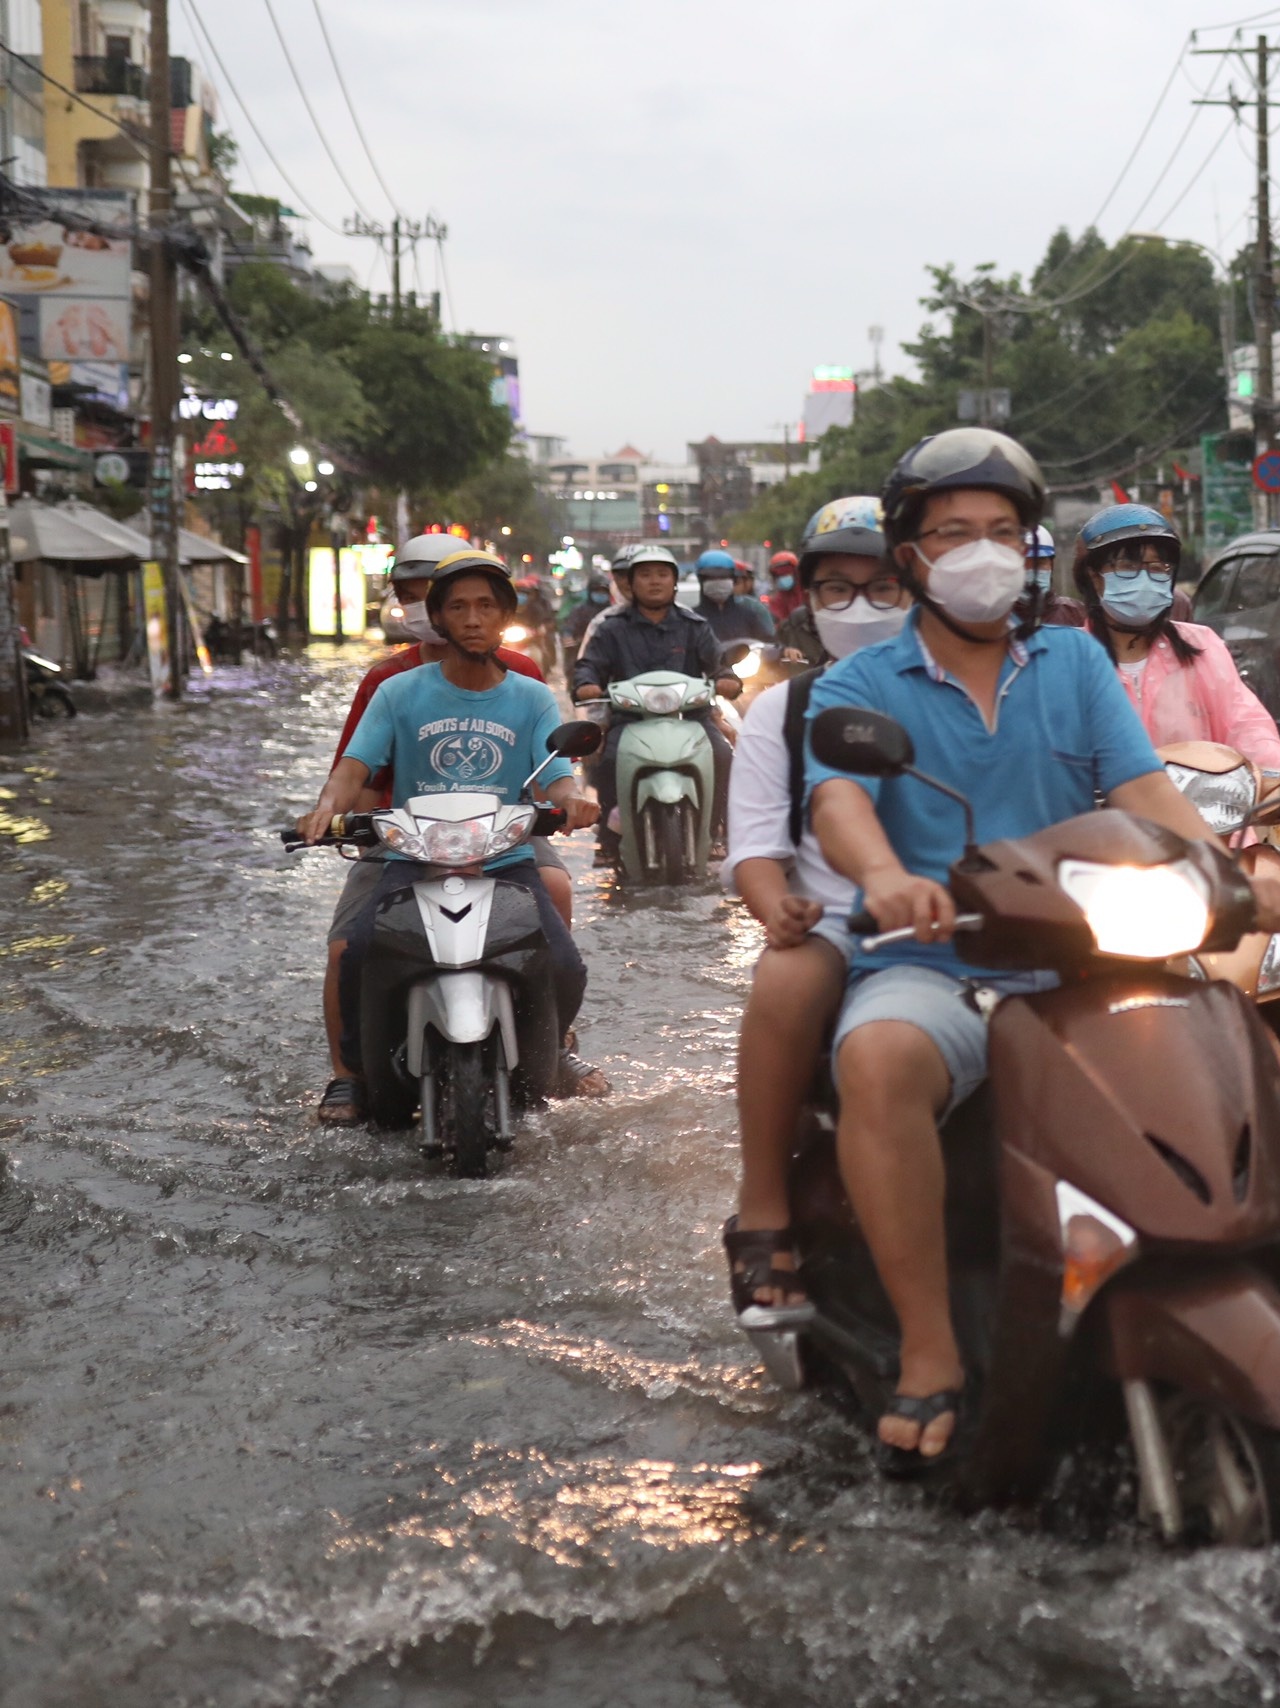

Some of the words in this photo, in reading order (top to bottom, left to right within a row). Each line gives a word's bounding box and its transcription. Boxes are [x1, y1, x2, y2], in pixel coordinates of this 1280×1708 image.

[418, 717, 459, 742] SPORTS
[459, 718, 470, 732] of
[485, 721, 516, 747] SORTS
[416, 781, 447, 792] Youth
[450, 782, 508, 794] Association
